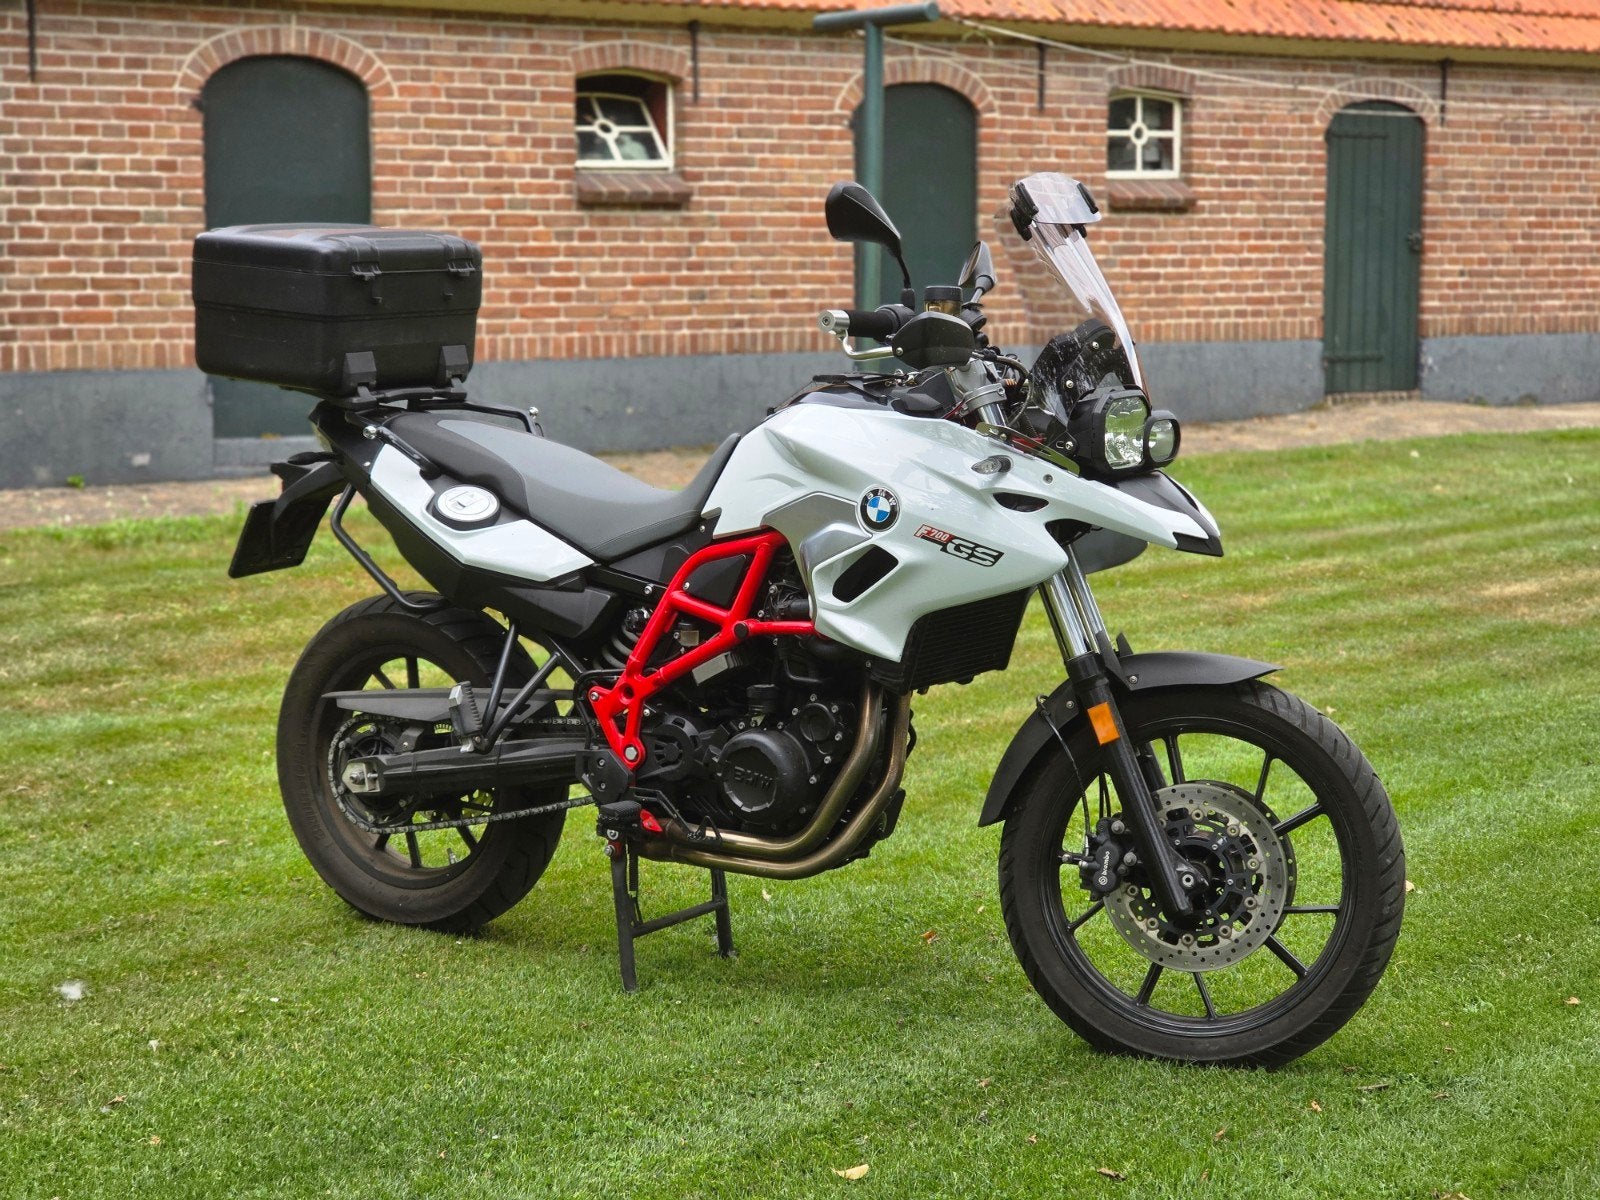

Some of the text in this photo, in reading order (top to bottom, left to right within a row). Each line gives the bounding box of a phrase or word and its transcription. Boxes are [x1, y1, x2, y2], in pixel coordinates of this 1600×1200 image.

[866, 489, 897, 506] BMW
[945, 538, 1001, 566] GS
[1102, 851, 1110, 875] brembo
